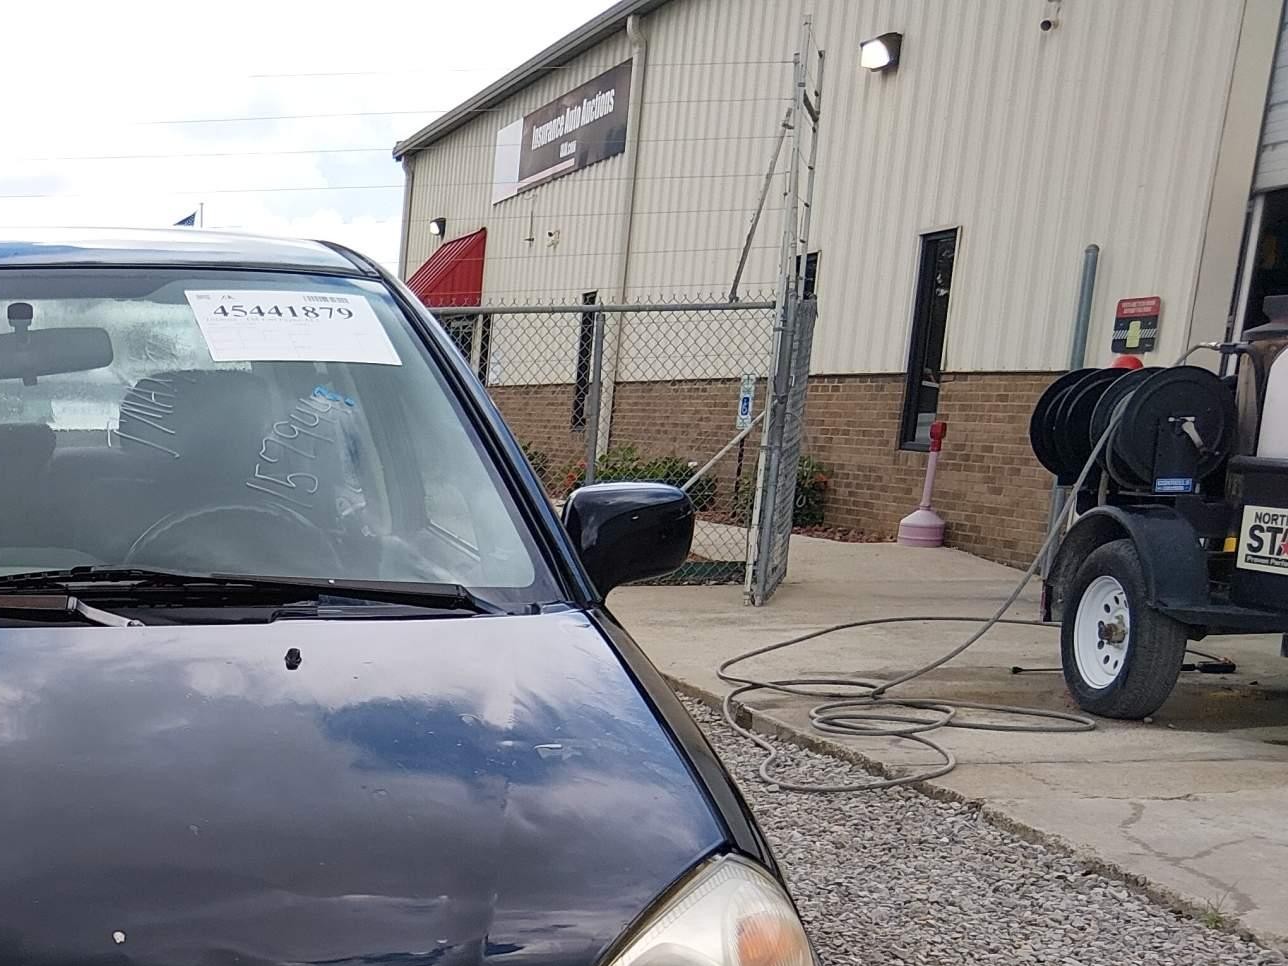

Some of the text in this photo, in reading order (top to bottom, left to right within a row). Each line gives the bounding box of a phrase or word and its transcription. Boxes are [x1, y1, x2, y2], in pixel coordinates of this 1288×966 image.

[532, 114, 565, 150] Insurance
[564, 105, 582, 135] Auto
[580, 88, 615, 127] Auctions
[213, 304, 354, 320] 45441879
